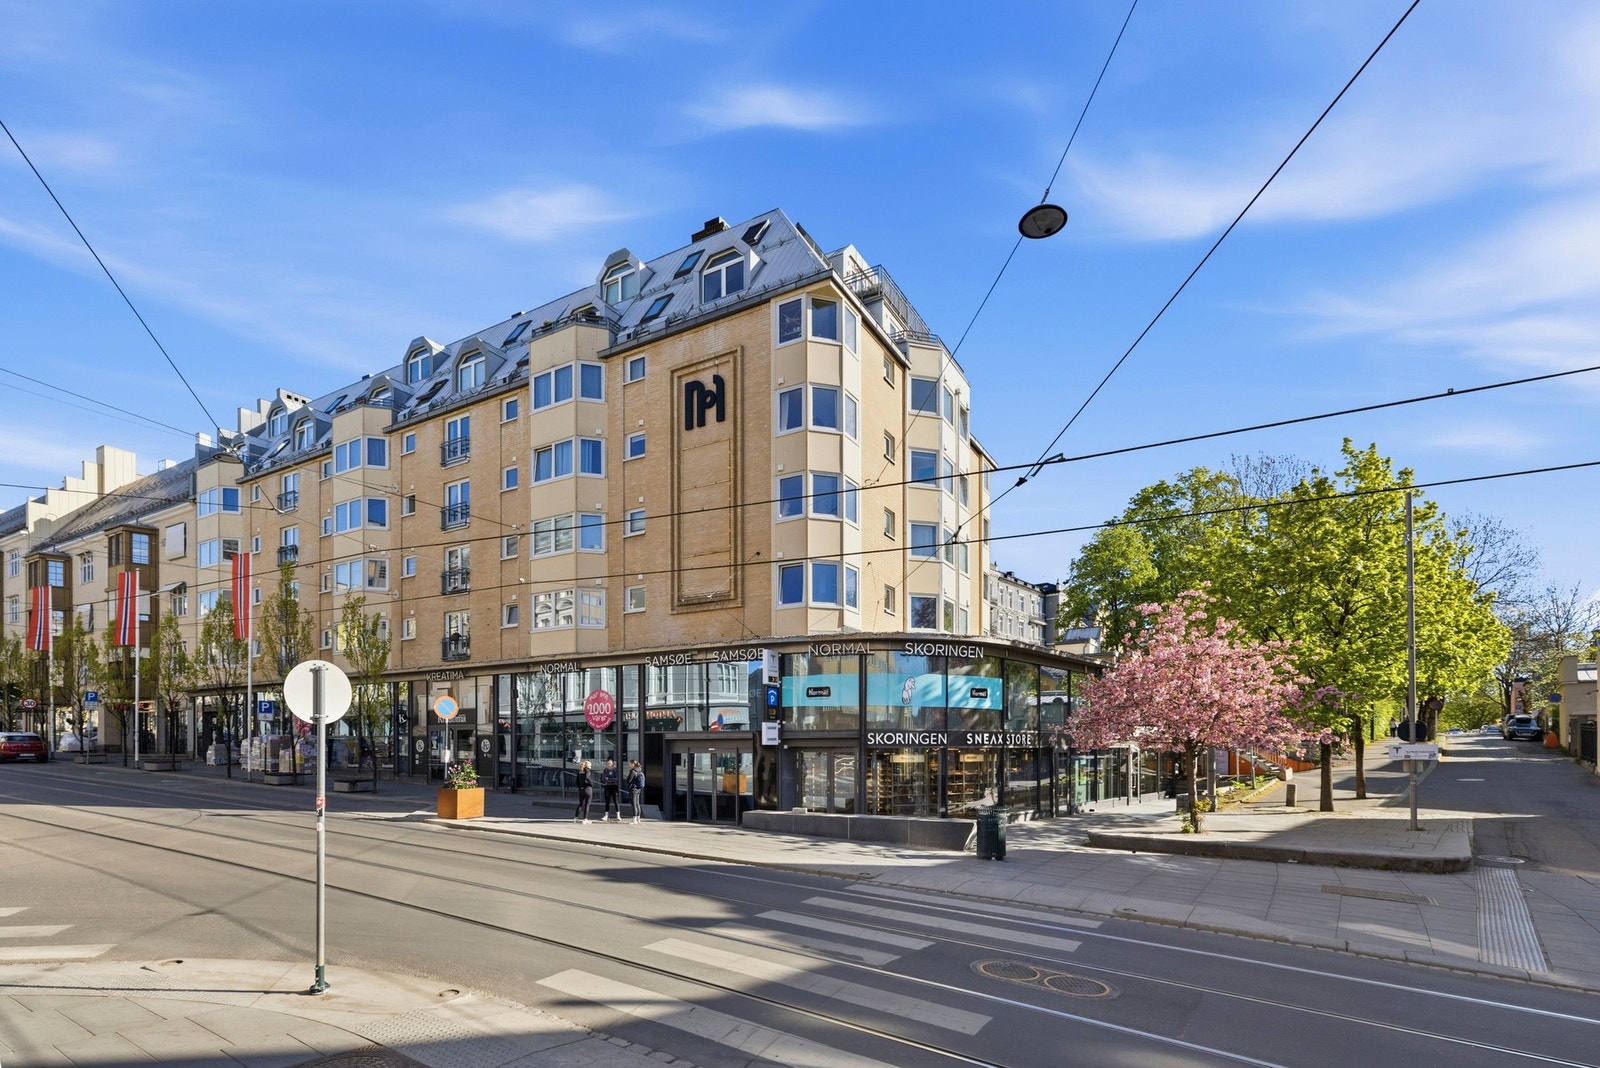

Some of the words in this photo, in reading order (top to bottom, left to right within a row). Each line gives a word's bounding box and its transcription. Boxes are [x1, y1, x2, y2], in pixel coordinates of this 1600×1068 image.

[808, 642, 875, 657] NORMAL
[905, 642, 984, 659] SKORINGEN
[645, 653, 692, 667] SAMSØE
[712, 648, 764, 662] SAMSØE
[540, 662, 580, 674] NORMAL
[426, 670, 464, 681] KREATIMA
[88, 692, 95, 700] P
[261, 702, 270, 712] P
[587, 702, 611, 715] 2000
[867, 732, 948, 745] SKORINGEN
[966, 733, 1003, 745] SNEAX
[1006, 733, 1032, 746] STORE
